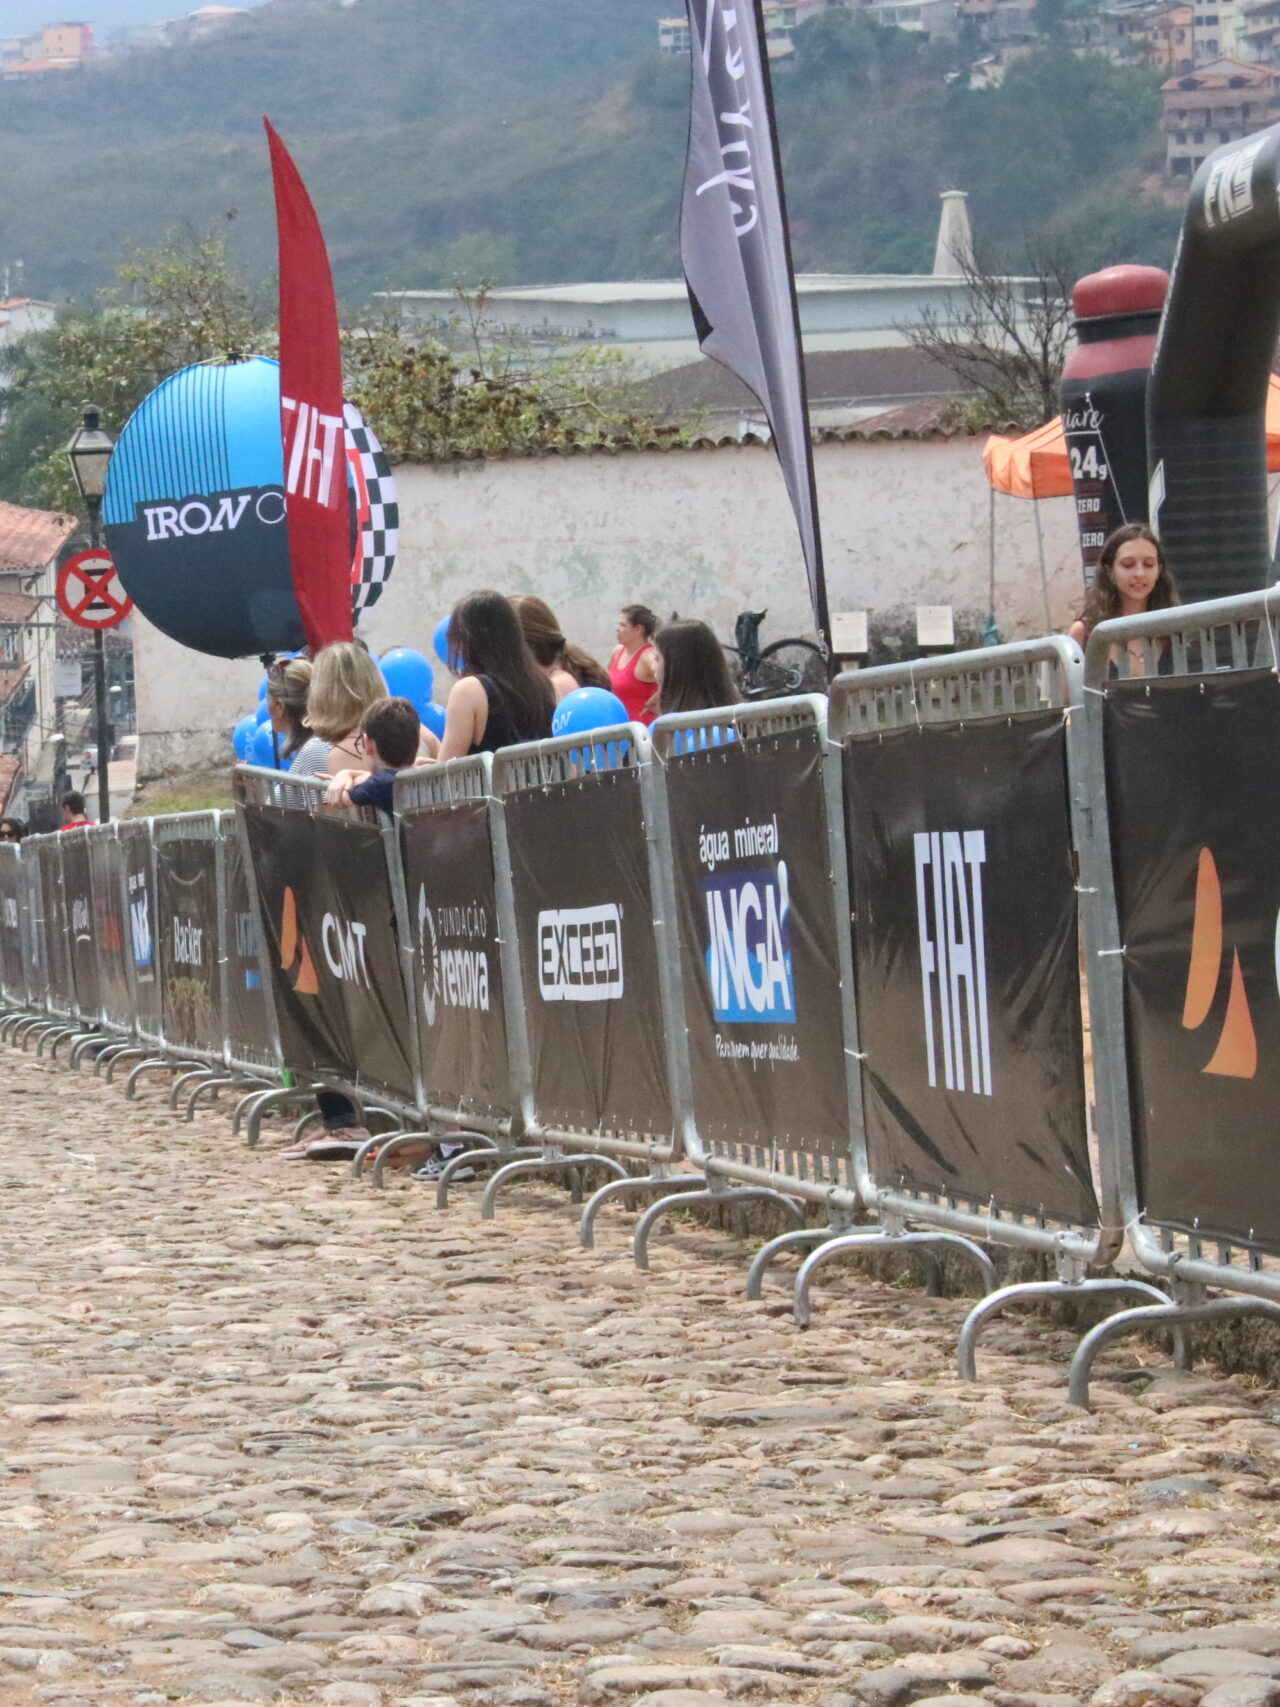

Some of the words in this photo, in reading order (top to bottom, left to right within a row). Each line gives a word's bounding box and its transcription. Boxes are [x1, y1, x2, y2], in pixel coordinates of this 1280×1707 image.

[143, 494, 252, 541] IRON
[1078, 498, 1100, 514] ZERO
[1082, 532, 1105, 548] ZERO
[699, 824, 729, 872] água
[734, 813, 779, 859] mineral
[173, 915, 203, 967] Backer
[437, 900, 487, 941] FUNDAÇÃO
[321, 912, 371, 990] CMT
[913, 829, 993, 1097] FIAT
[439, 949, 490, 1011] renova
